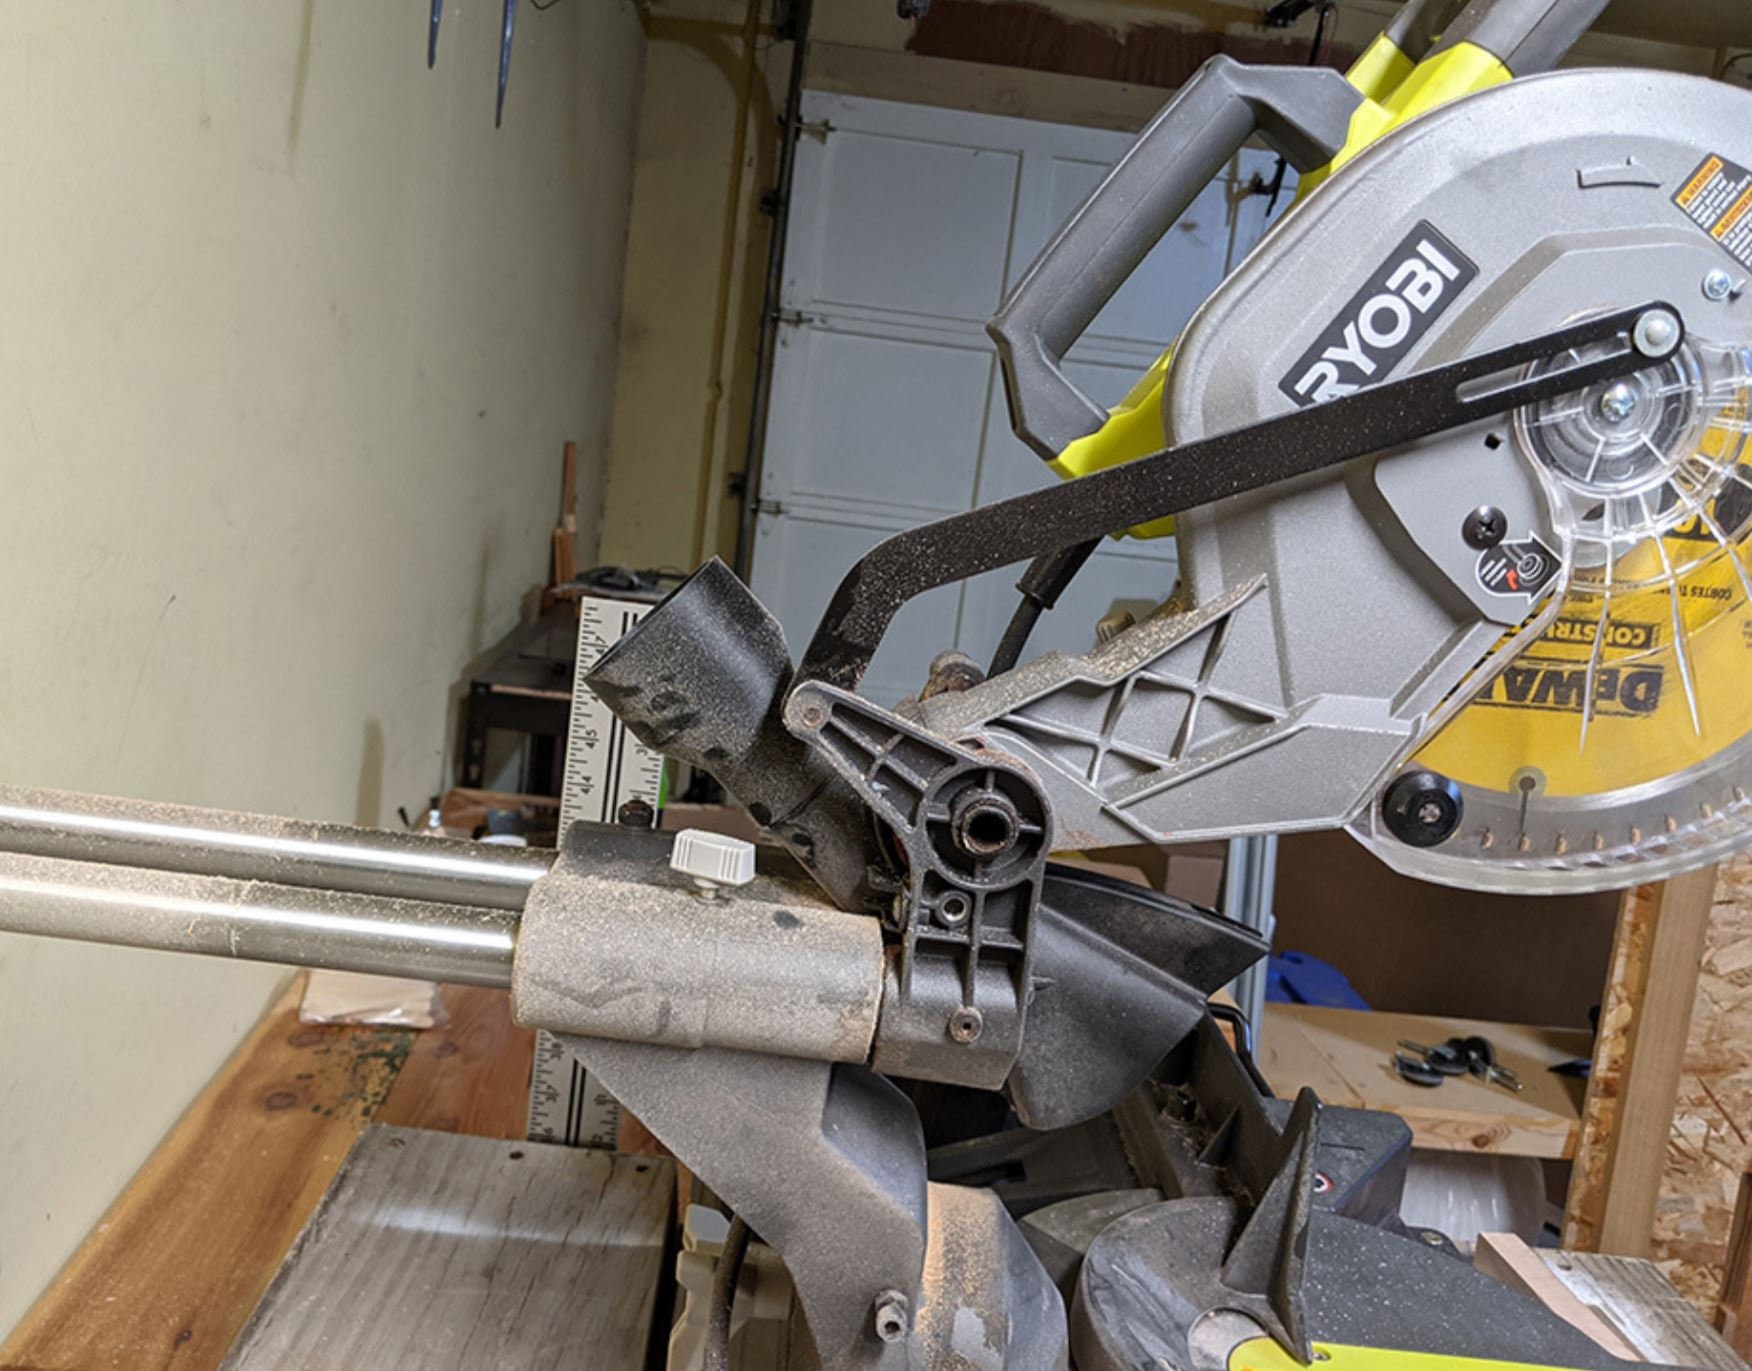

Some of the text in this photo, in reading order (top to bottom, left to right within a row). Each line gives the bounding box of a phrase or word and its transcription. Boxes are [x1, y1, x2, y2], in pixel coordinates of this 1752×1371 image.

[1294, 239, 1460, 403] RYOBI
[1476, 669, 1664, 713] DEWA
[585, 728, 598, 750] 45
[580, 774, 592, 795] 44
